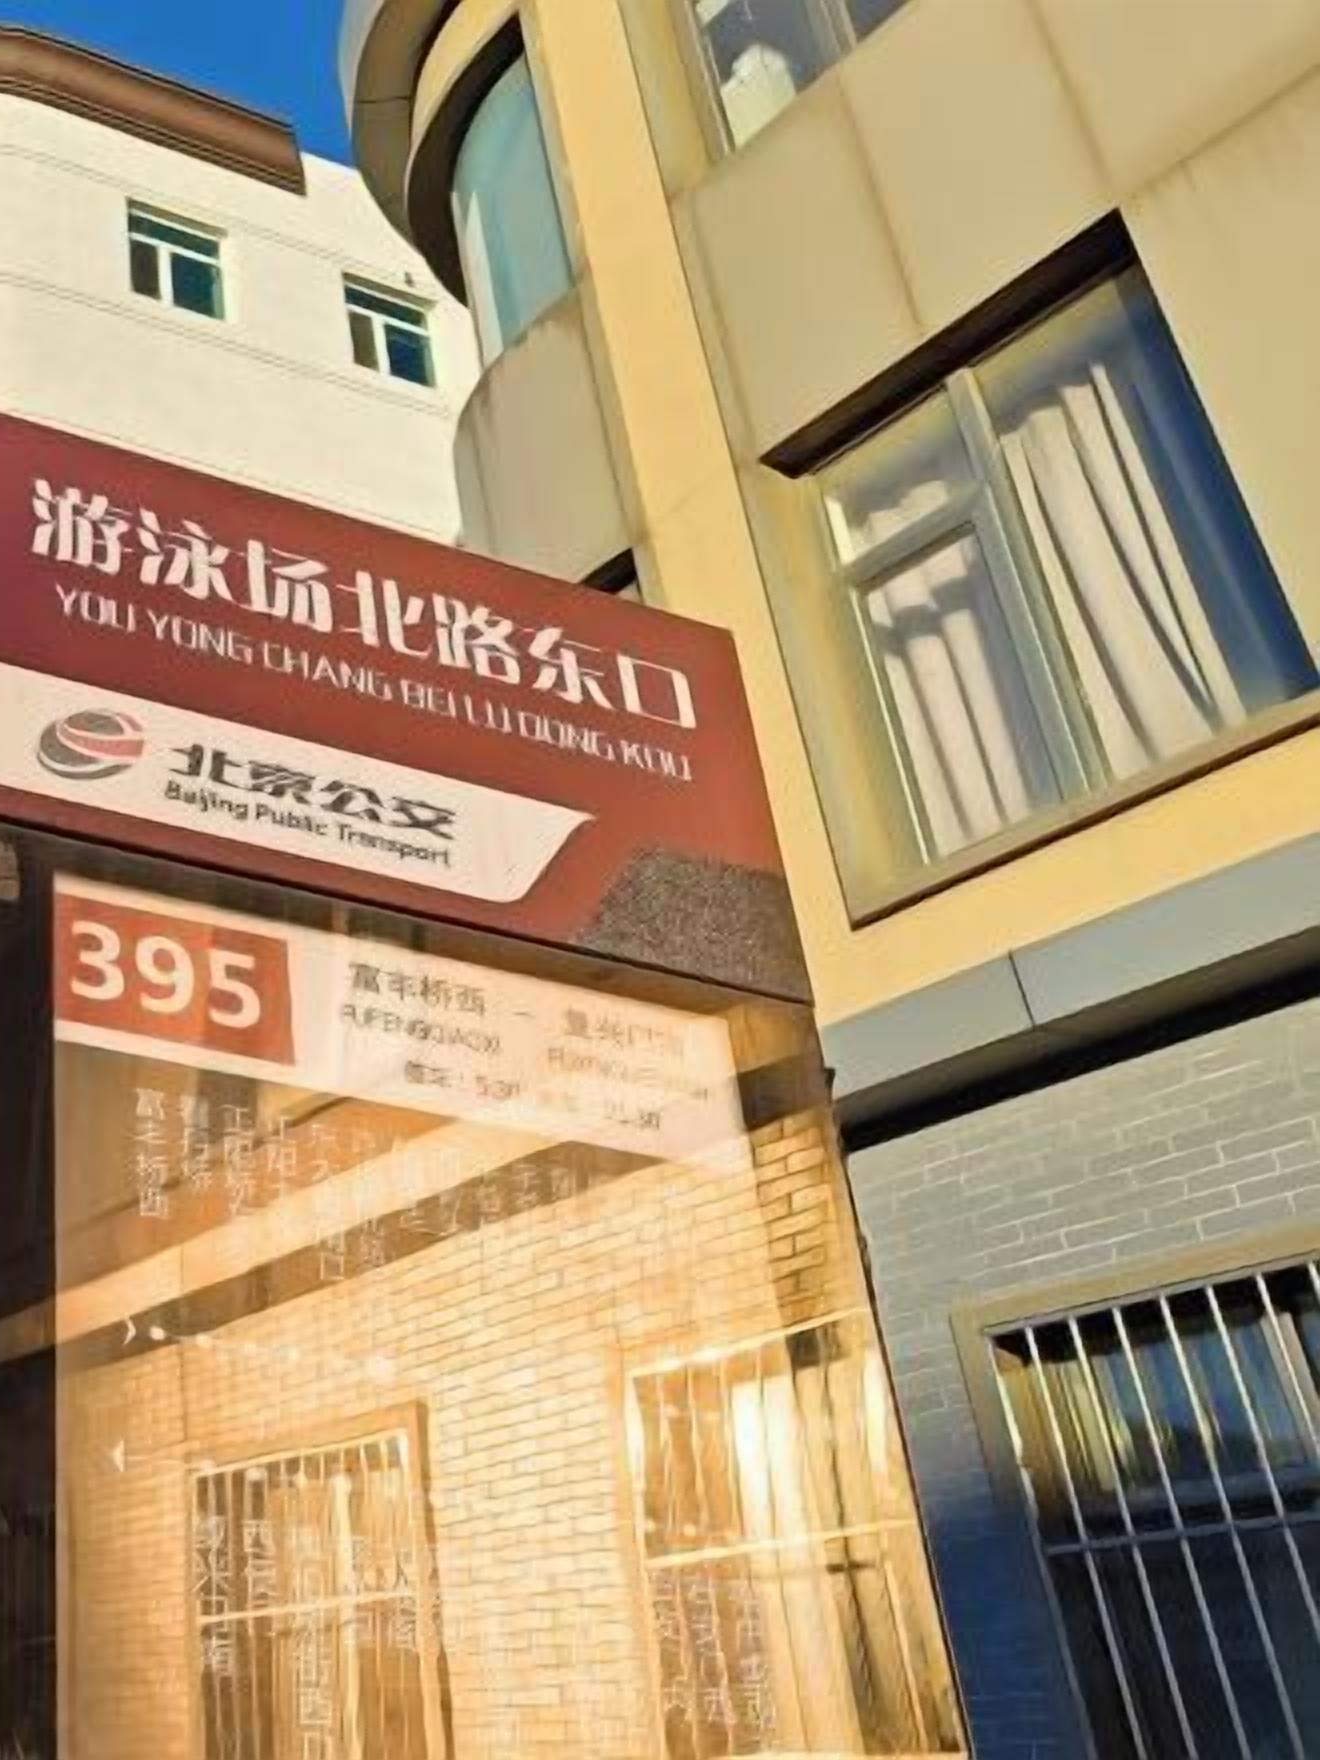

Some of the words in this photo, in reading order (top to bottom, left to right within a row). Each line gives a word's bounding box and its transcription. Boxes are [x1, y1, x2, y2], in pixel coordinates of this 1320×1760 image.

[31, 478, 697, 729] 游泳场北路东口
[55, 581, 136, 633] YOU
[147, 608, 253, 666] YONG
[262, 639, 393, 701] CHANG
[399, 677, 457, 719] BEI
[464, 694, 513, 735] LU
[516, 709, 616, 762] DONG
[619, 738, 693, 782] KOU
[164, 779, 249, 821] Beijing
[255, 802, 329, 837] Public
[336, 822, 451, 867] Transport
[168, 742, 457, 841] 北京公交
[70, 919, 262, 1030] 395
